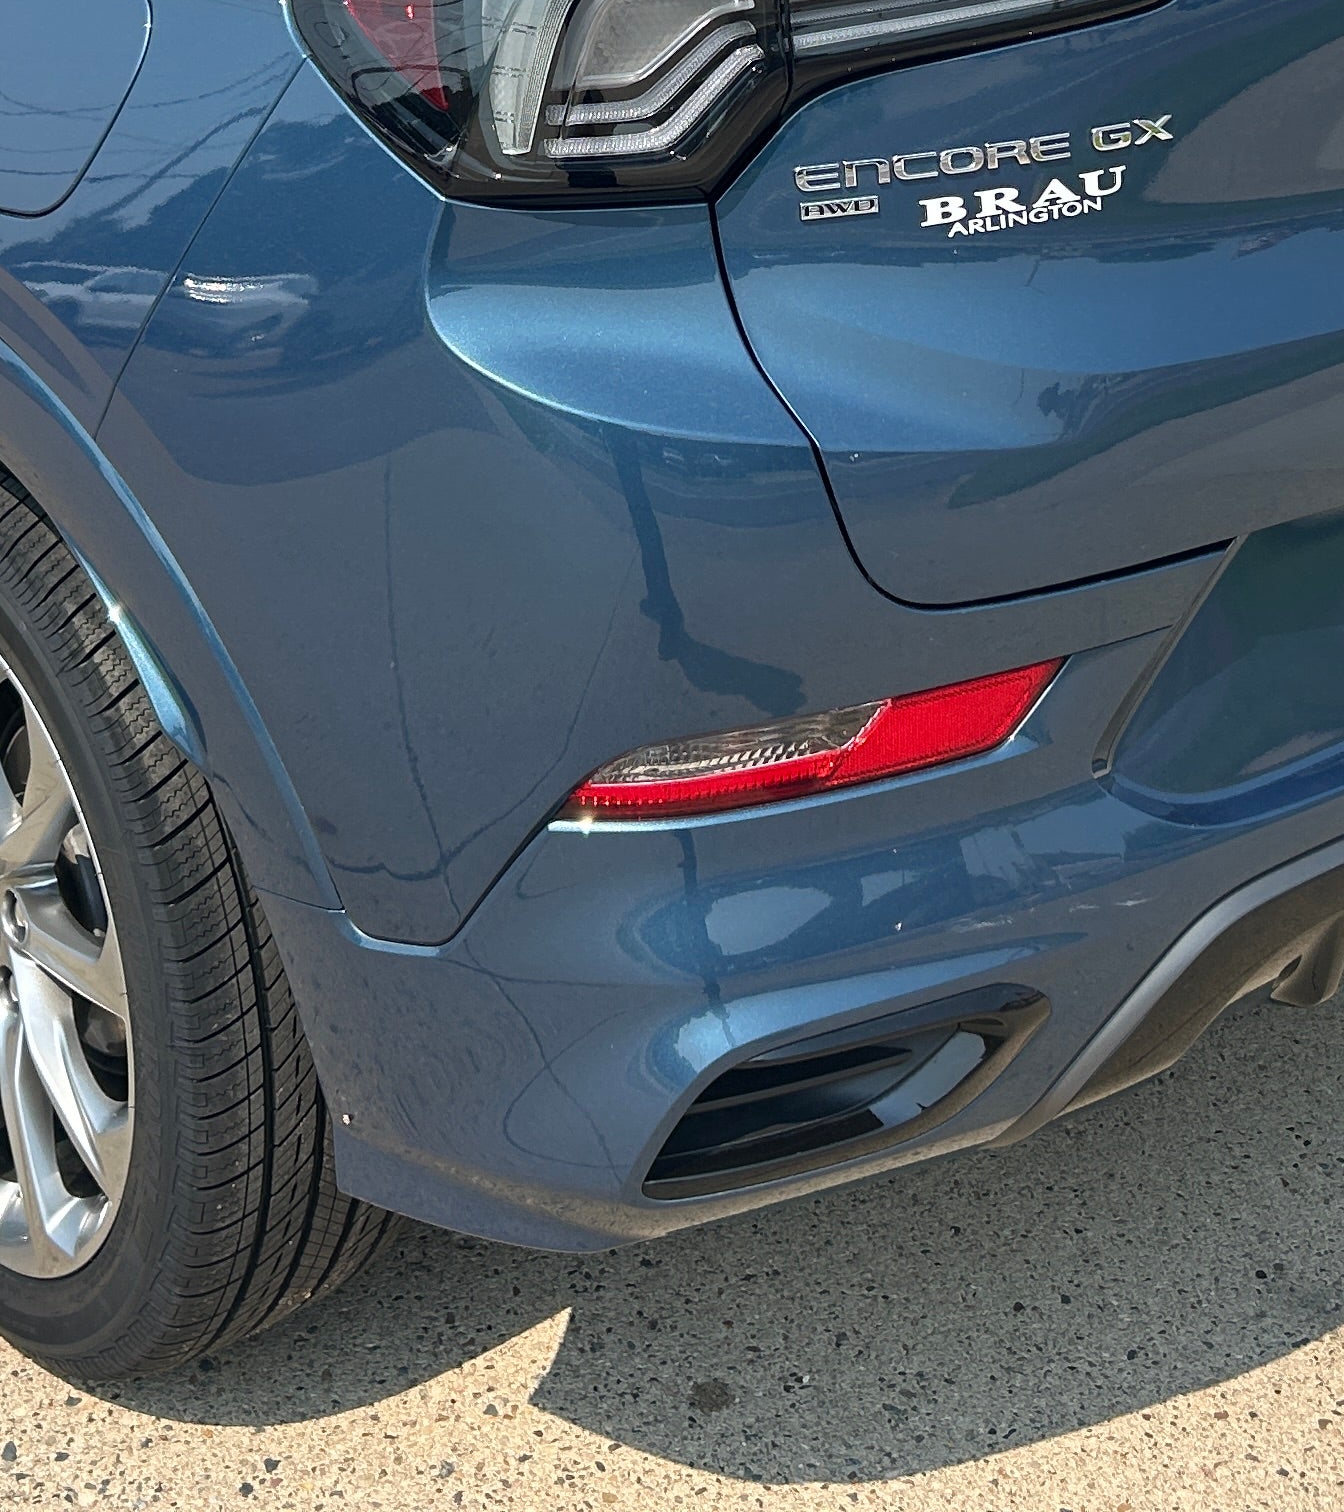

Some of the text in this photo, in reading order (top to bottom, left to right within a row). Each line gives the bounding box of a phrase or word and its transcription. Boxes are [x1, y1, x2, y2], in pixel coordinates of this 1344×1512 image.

[794, 114, 1174, 193] ENCORE GX
[801, 198, 877, 219] AWD
[918, 165, 1128, 229] BRAU
[947, 197, 1103, 238] ARLINGTON
